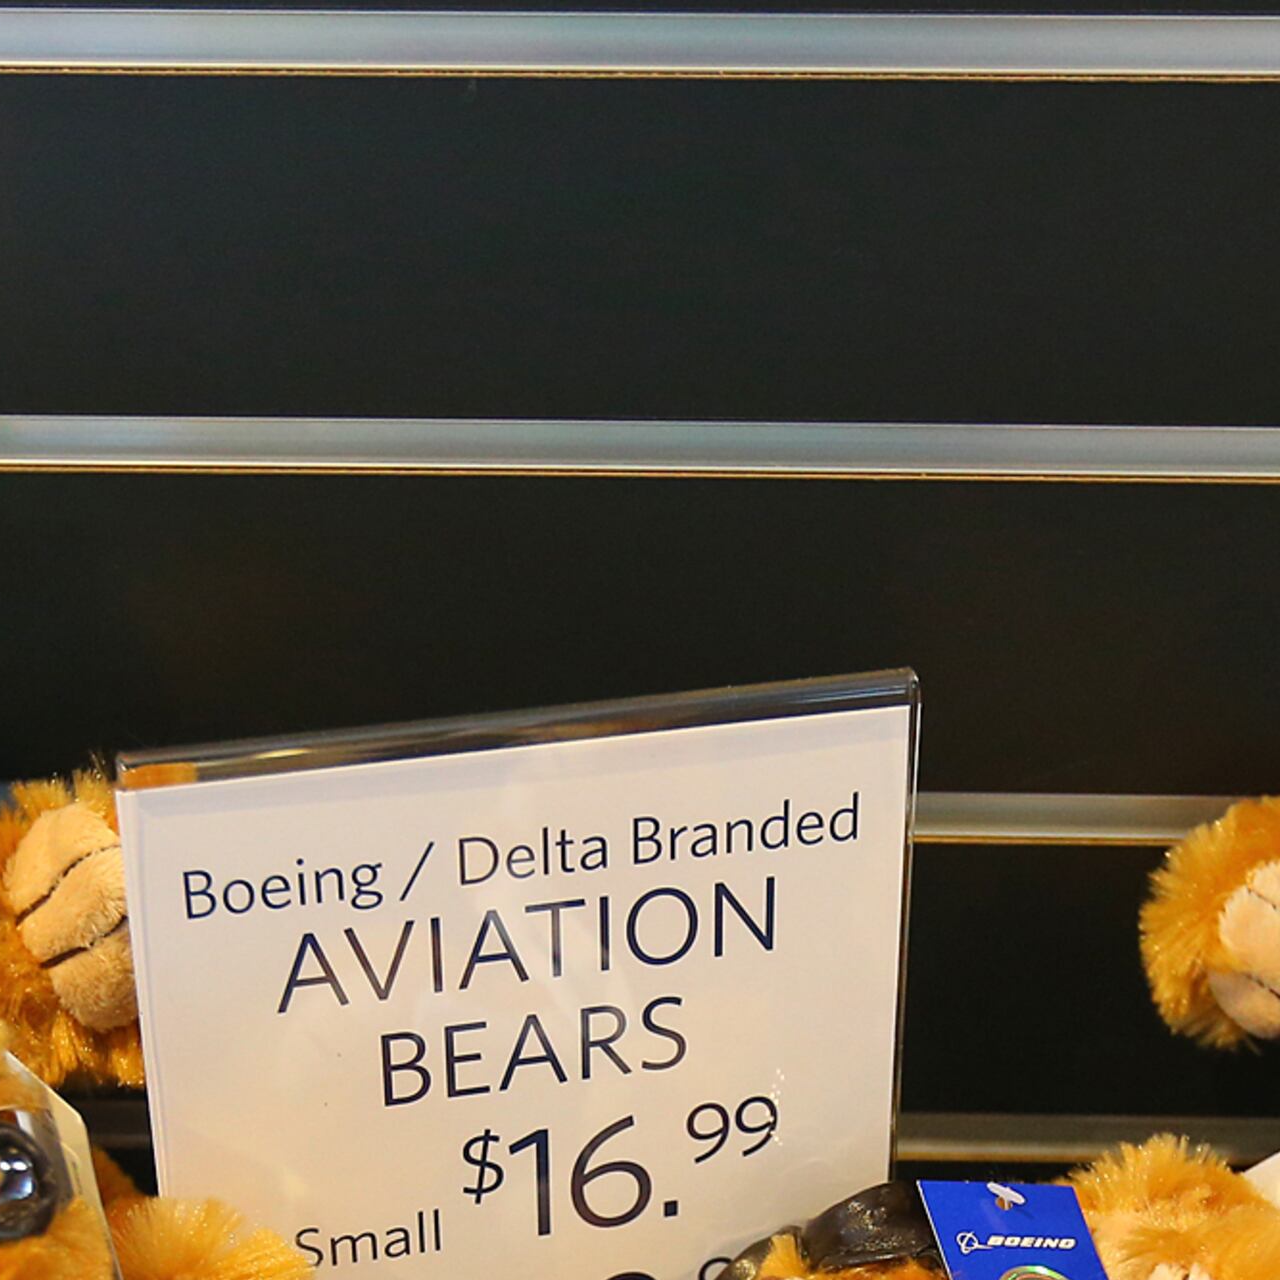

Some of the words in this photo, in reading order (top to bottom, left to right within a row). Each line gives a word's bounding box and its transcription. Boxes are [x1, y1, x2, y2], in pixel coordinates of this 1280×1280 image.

[182, 858, 384, 919] Boeing
[399, 840, 435, 902] /
[458, 826, 609, 887] Delta
[631, 791, 860, 865] Branded
[277, 876, 776, 1014] AVIATION
[380, 996, 688, 1107] BEARS
[295, 1208, 442, 1267] Small
[461, 1094, 780, 1237] $16.99
[986, 1234, 1077, 1250] BOEING
